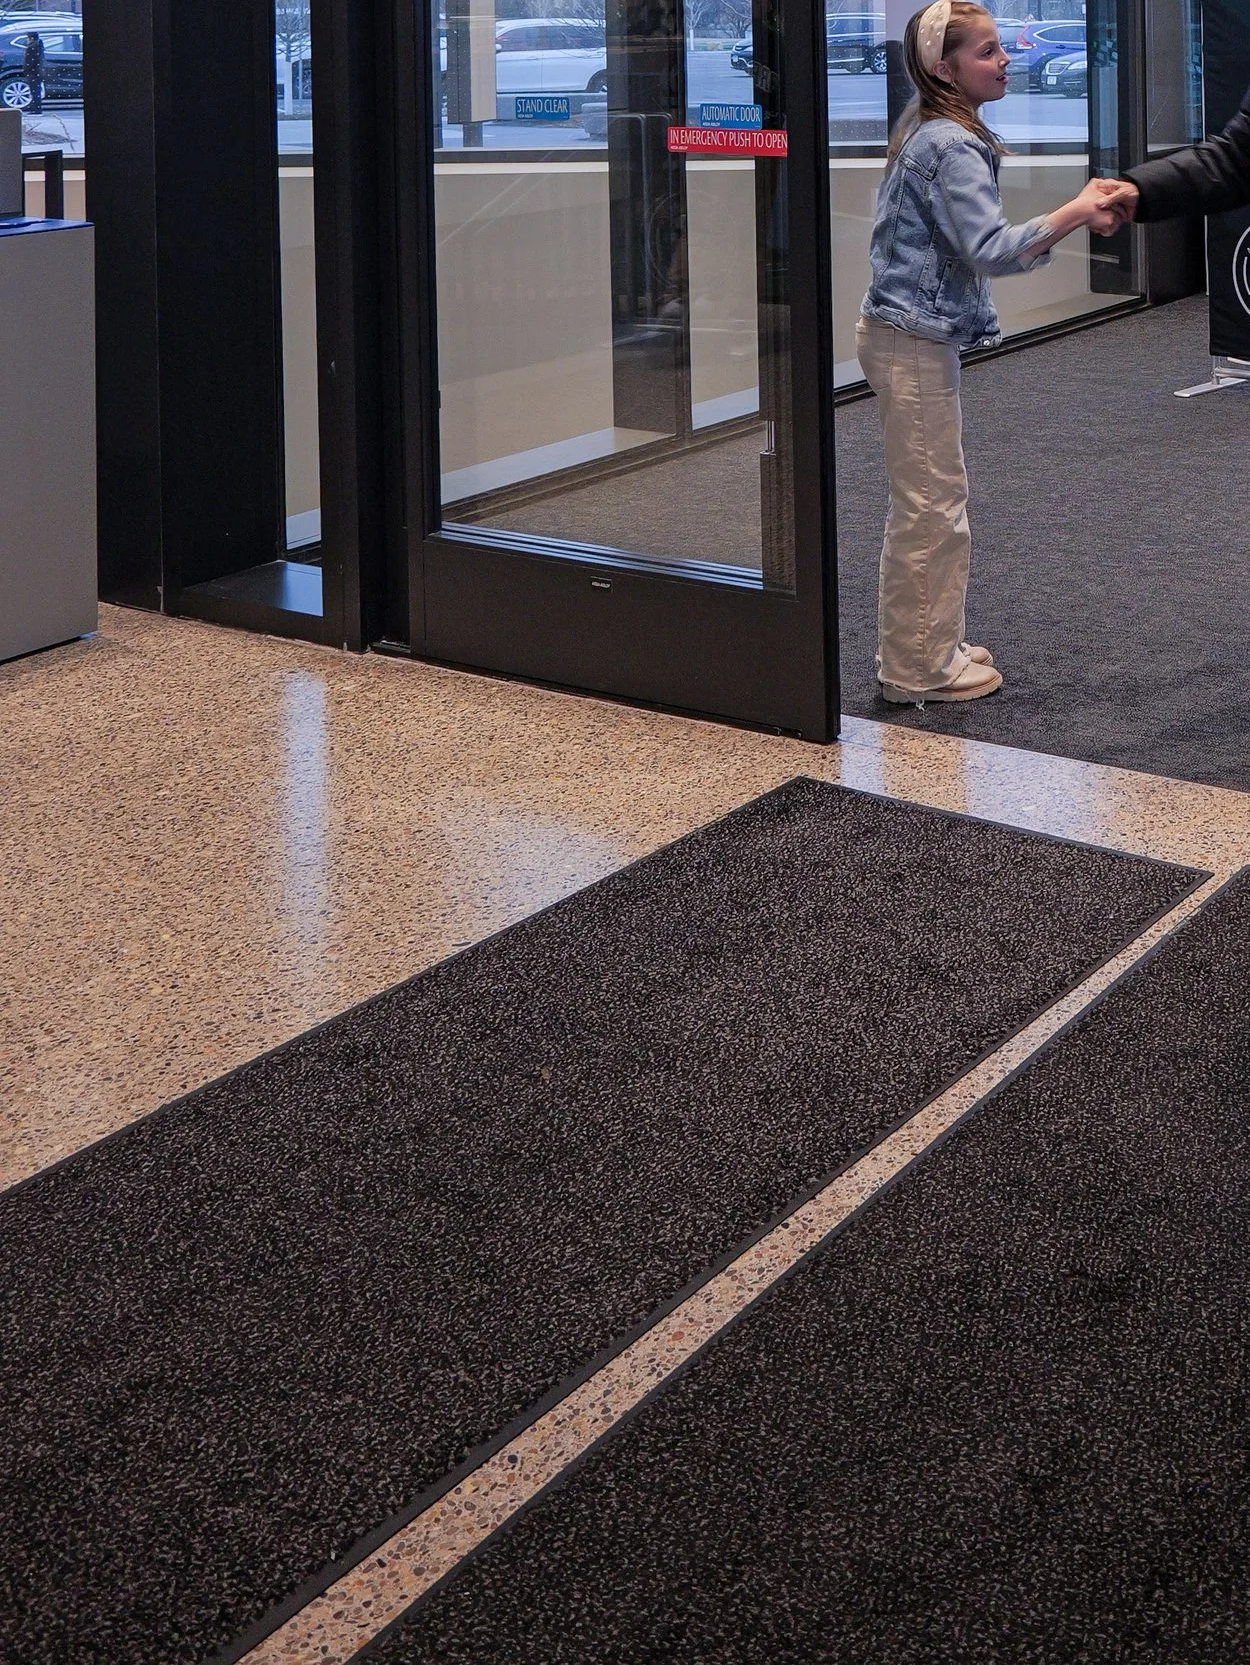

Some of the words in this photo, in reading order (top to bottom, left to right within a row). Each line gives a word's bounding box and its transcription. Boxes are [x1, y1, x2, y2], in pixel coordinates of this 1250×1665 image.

[516, 99, 543, 113] STAND
[544, 99, 568, 113] CLEAR
[701, 106, 739, 122] AUTOMATIC
[740, 107, 761, 122] DOOR
[670, 129, 680, 145] IN
[681, 129, 728, 147] EMERGENCY
[729, 131, 751, 148] PUSH
[752, 132, 765, 148] TO
[765, 133, 788, 150] OPEN
